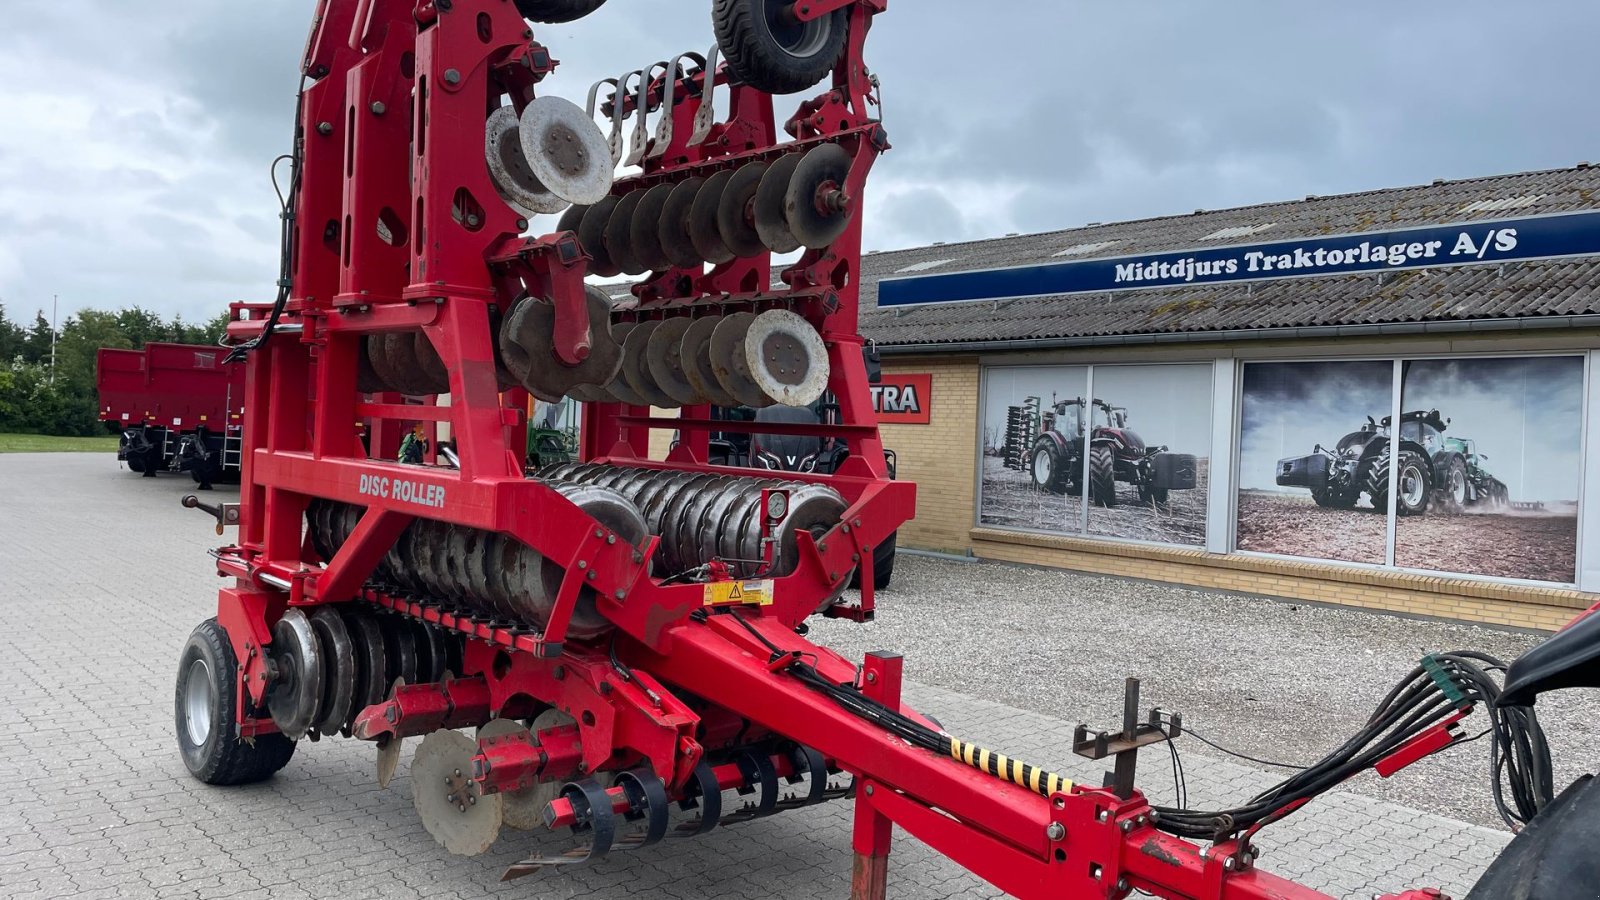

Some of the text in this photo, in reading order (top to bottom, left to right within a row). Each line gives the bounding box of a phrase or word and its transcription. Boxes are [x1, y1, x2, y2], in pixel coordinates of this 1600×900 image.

[1114, 228, 1518, 282] Midtdjurs Traktorlager A/S
[359, 474, 445, 508] DISC ROLLER
